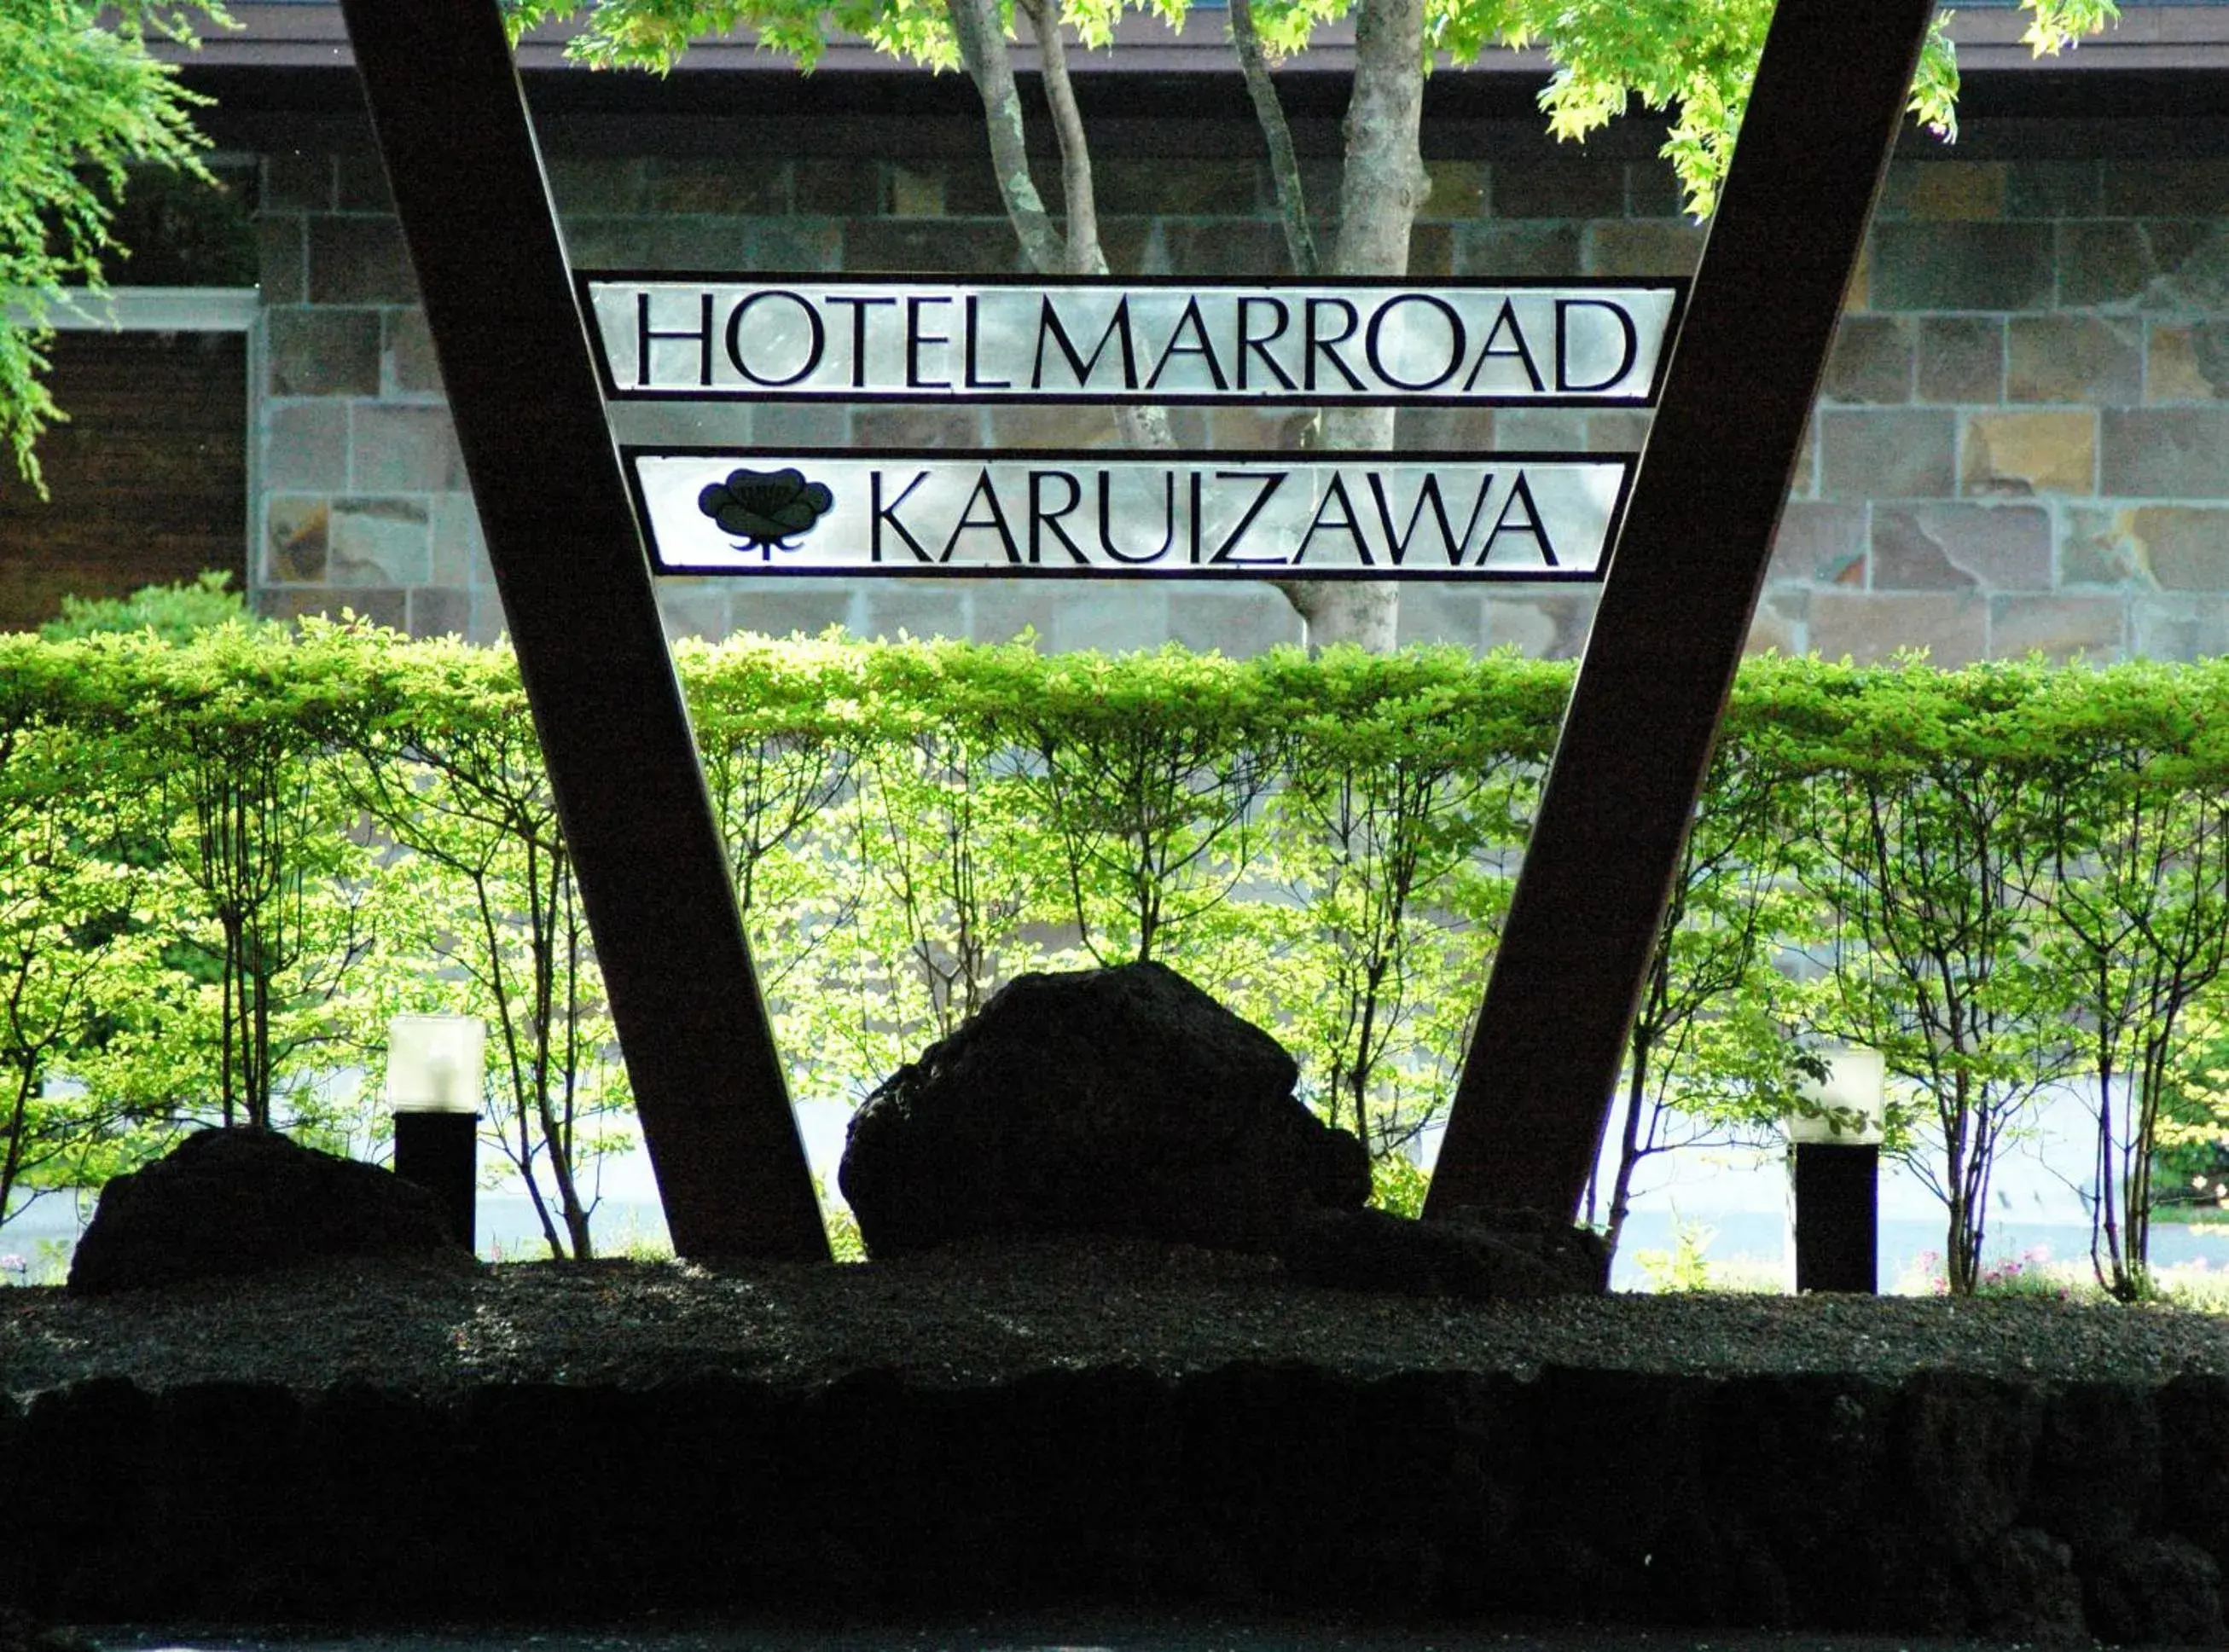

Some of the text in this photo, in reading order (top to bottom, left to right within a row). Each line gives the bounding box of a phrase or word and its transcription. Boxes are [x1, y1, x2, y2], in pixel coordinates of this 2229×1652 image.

[637, 290, 1638, 392] HOTEL MARROAD
[870, 466, 1559, 566] KARUIZAWA
